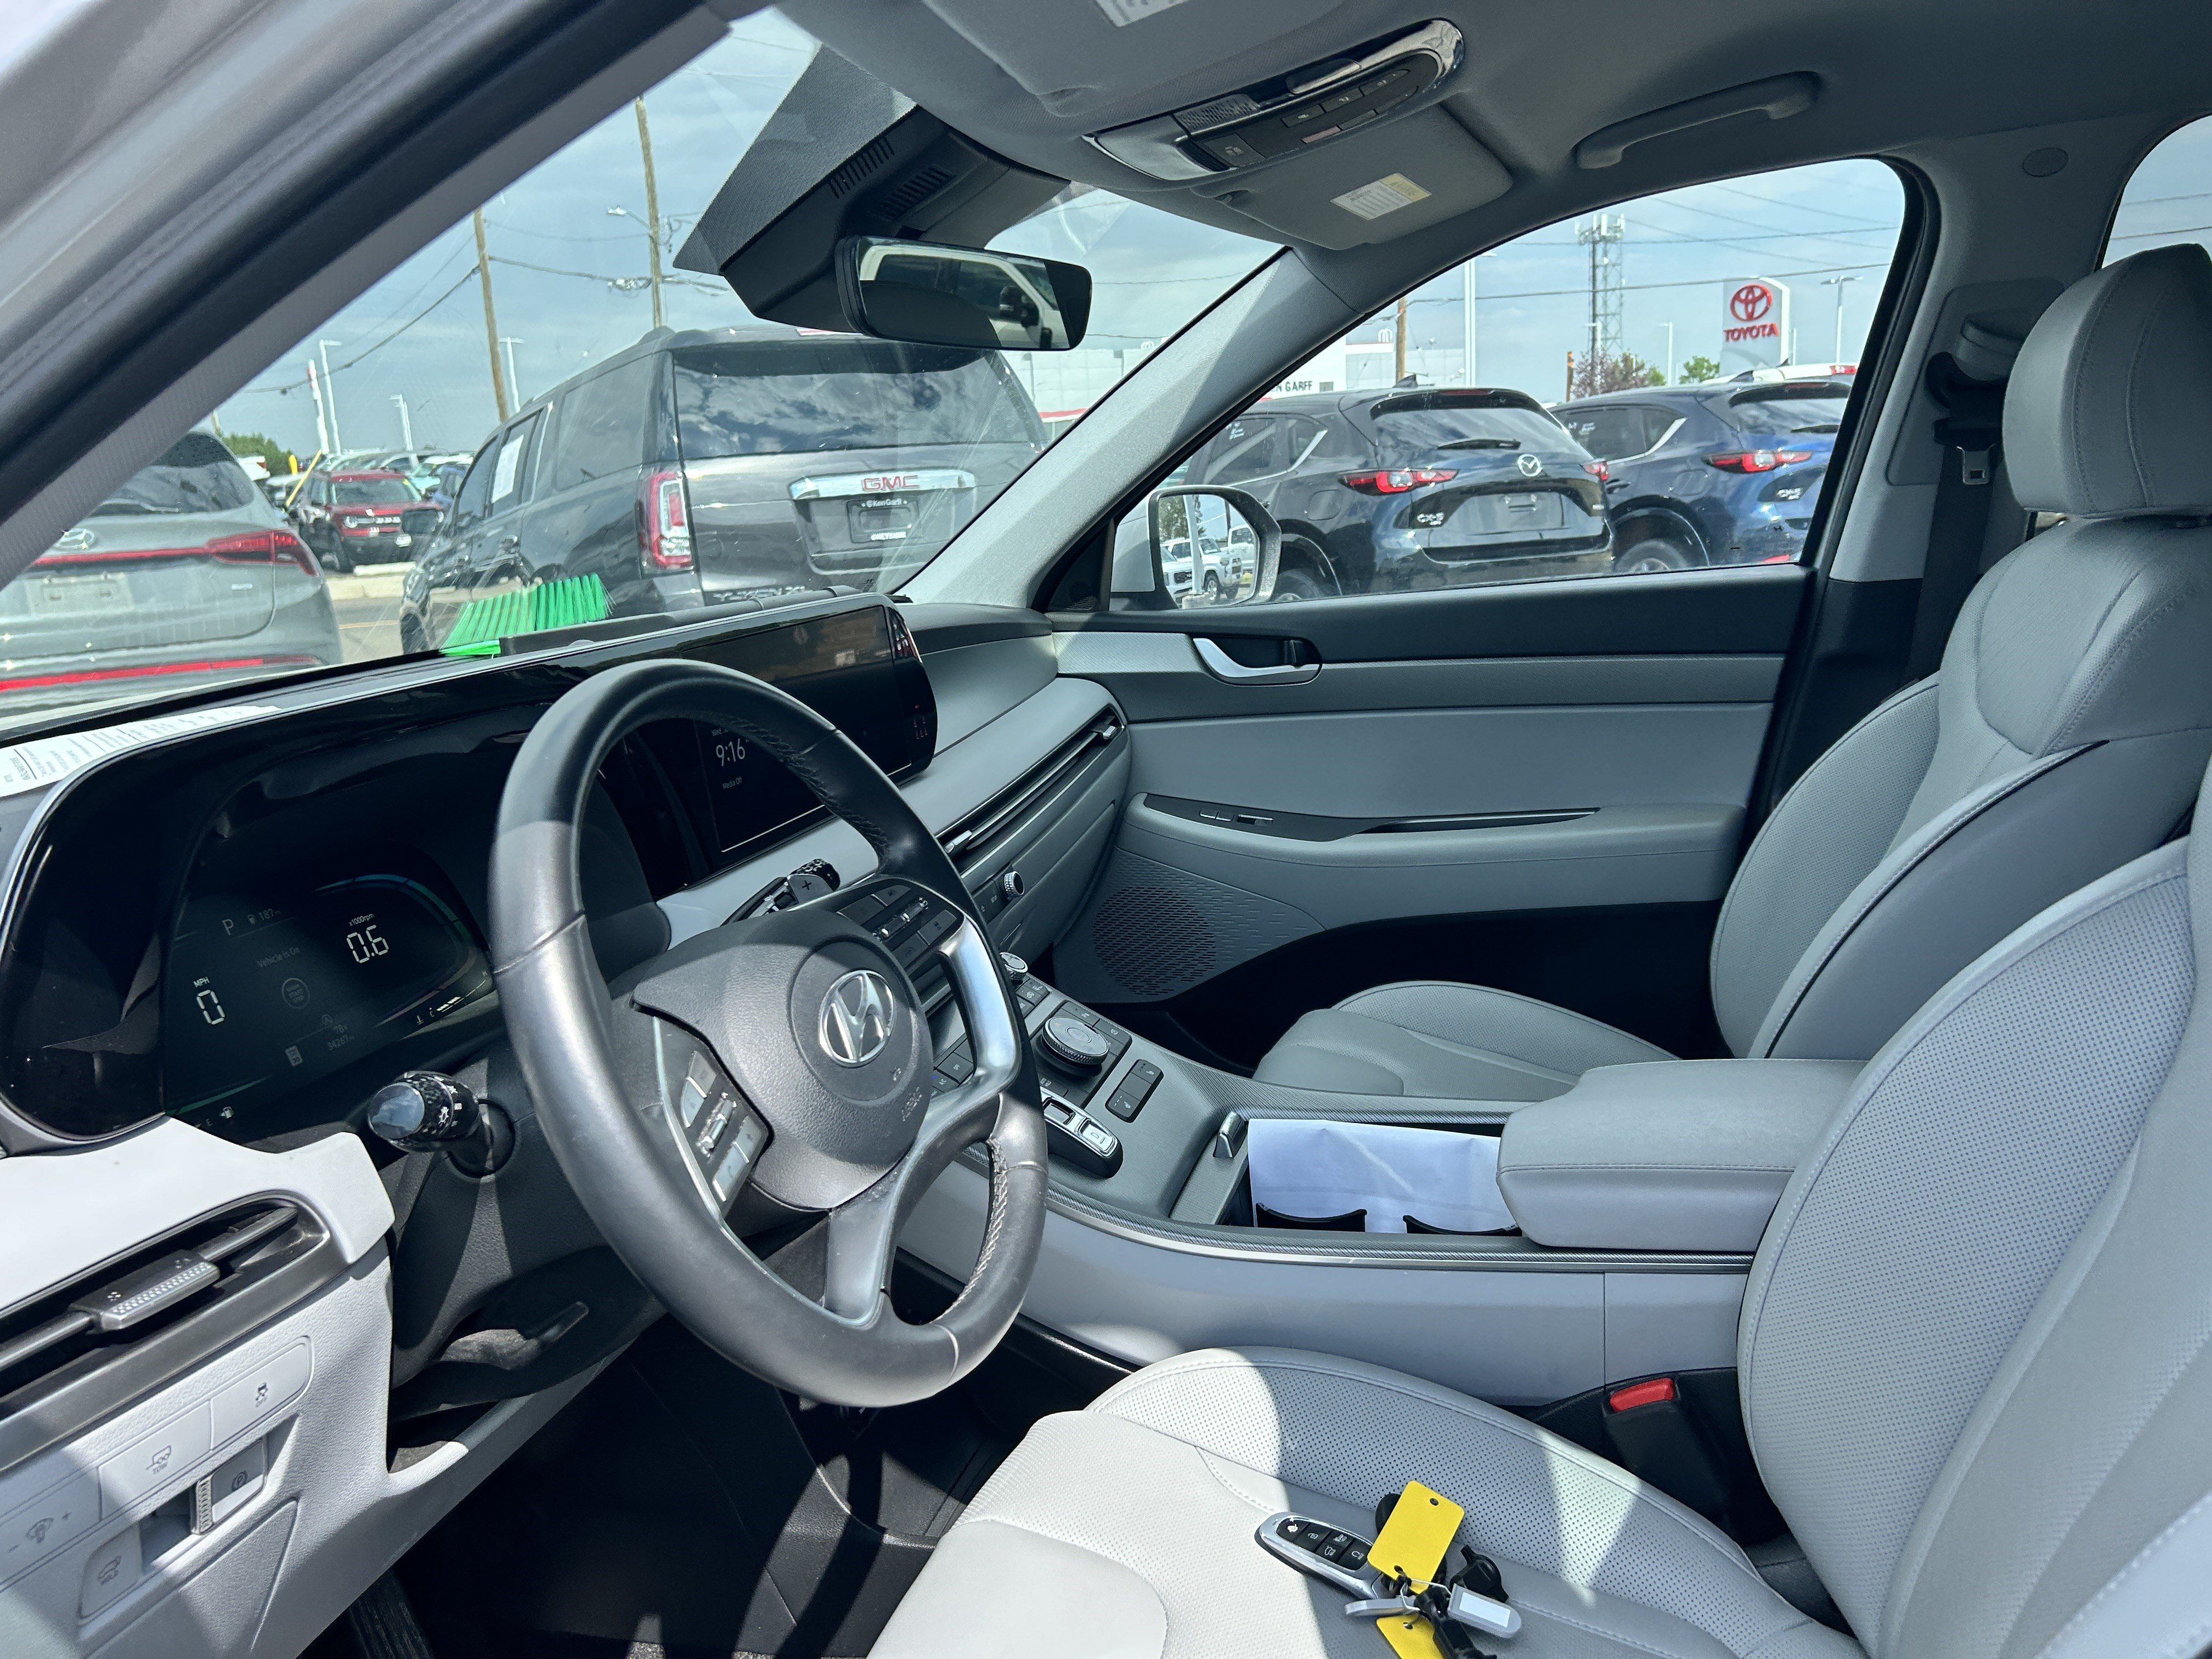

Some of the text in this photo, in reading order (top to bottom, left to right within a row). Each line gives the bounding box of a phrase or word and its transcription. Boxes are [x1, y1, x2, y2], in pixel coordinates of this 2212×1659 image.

[1723, 322, 1779, 342] TOYOTA
[1285, 380, 1313, 392] GARFF
[862, 475, 920, 492] GMC
[715, 738, 746, 766] 9:16
[222, 918, 234, 935] P
[258, 909, 274, 921] 187
[348, 913, 375, 927] x1000rpm
[346, 924, 390, 963] 0.6
[193, 977, 210, 988] MPH
[196, 989, 226, 1025] 0
